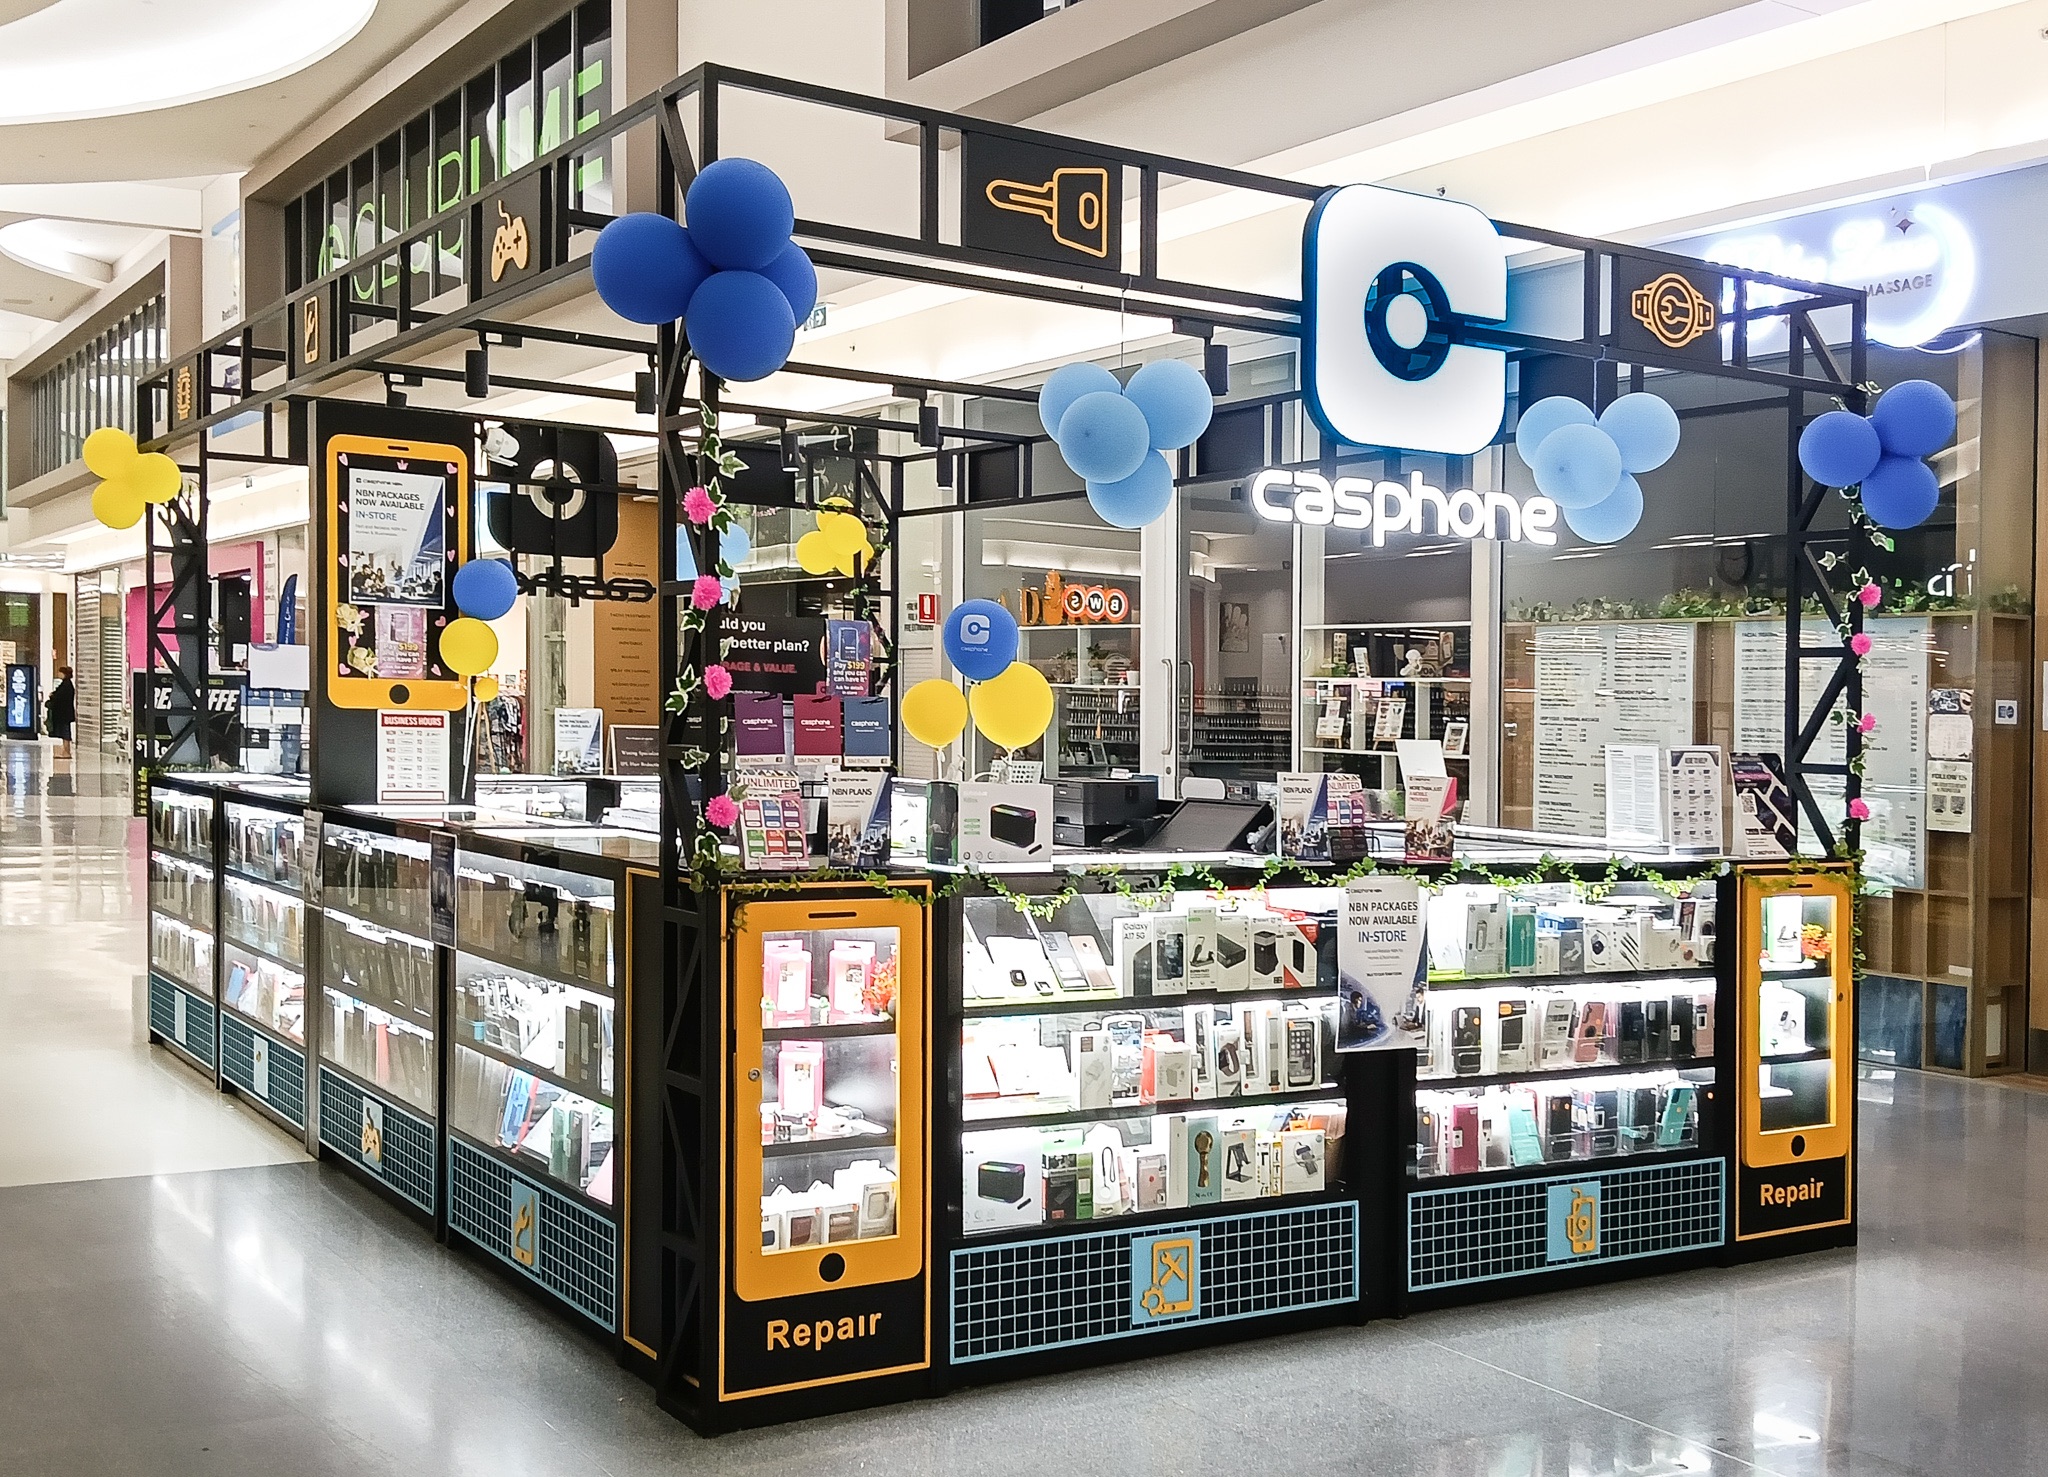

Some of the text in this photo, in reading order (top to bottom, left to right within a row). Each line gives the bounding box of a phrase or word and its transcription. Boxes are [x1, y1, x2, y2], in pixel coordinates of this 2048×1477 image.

[1862, 274, 1933, 297] MASSAGE
[356, 489, 420, 501] NBN PACKAGES
[380, 500, 425, 511] AVAILABLE
[1251, 468, 1559, 548] casphone
[356, 511, 397, 521] IN-STORE
[742, 621, 766, 633] you
[399, 643, 419, 651] $199
[731, 638, 771, 650] better
[774, 640, 810, 653] plan?
[834, 661, 866, 670] Pay $199
[384, 716, 442, 726] BUSINESS HOURS
[742, 718, 773, 727] casphone
[801, 718, 831, 727] casphone
[851, 720, 880, 728] casphone
[742, 777, 798, 789] UNLIMITED
[1328, 782, 1360, 790] NLIMITED
[832, 788, 873, 796] NBN PLANS
[1348, 901, 1419, 912] NBN PACKAGES
[1349, 915, 1418, 926] NOW AVAILABLE
[1123, 923, 1149, 932] Galaxy
[1124, 932, 1146, 940] A17 5G
[1358, 930, 1407, 943] IN-STORE
[1760, 1177, 1824, 1208] Repair
[766, 1312, 882, 1351] Repair
